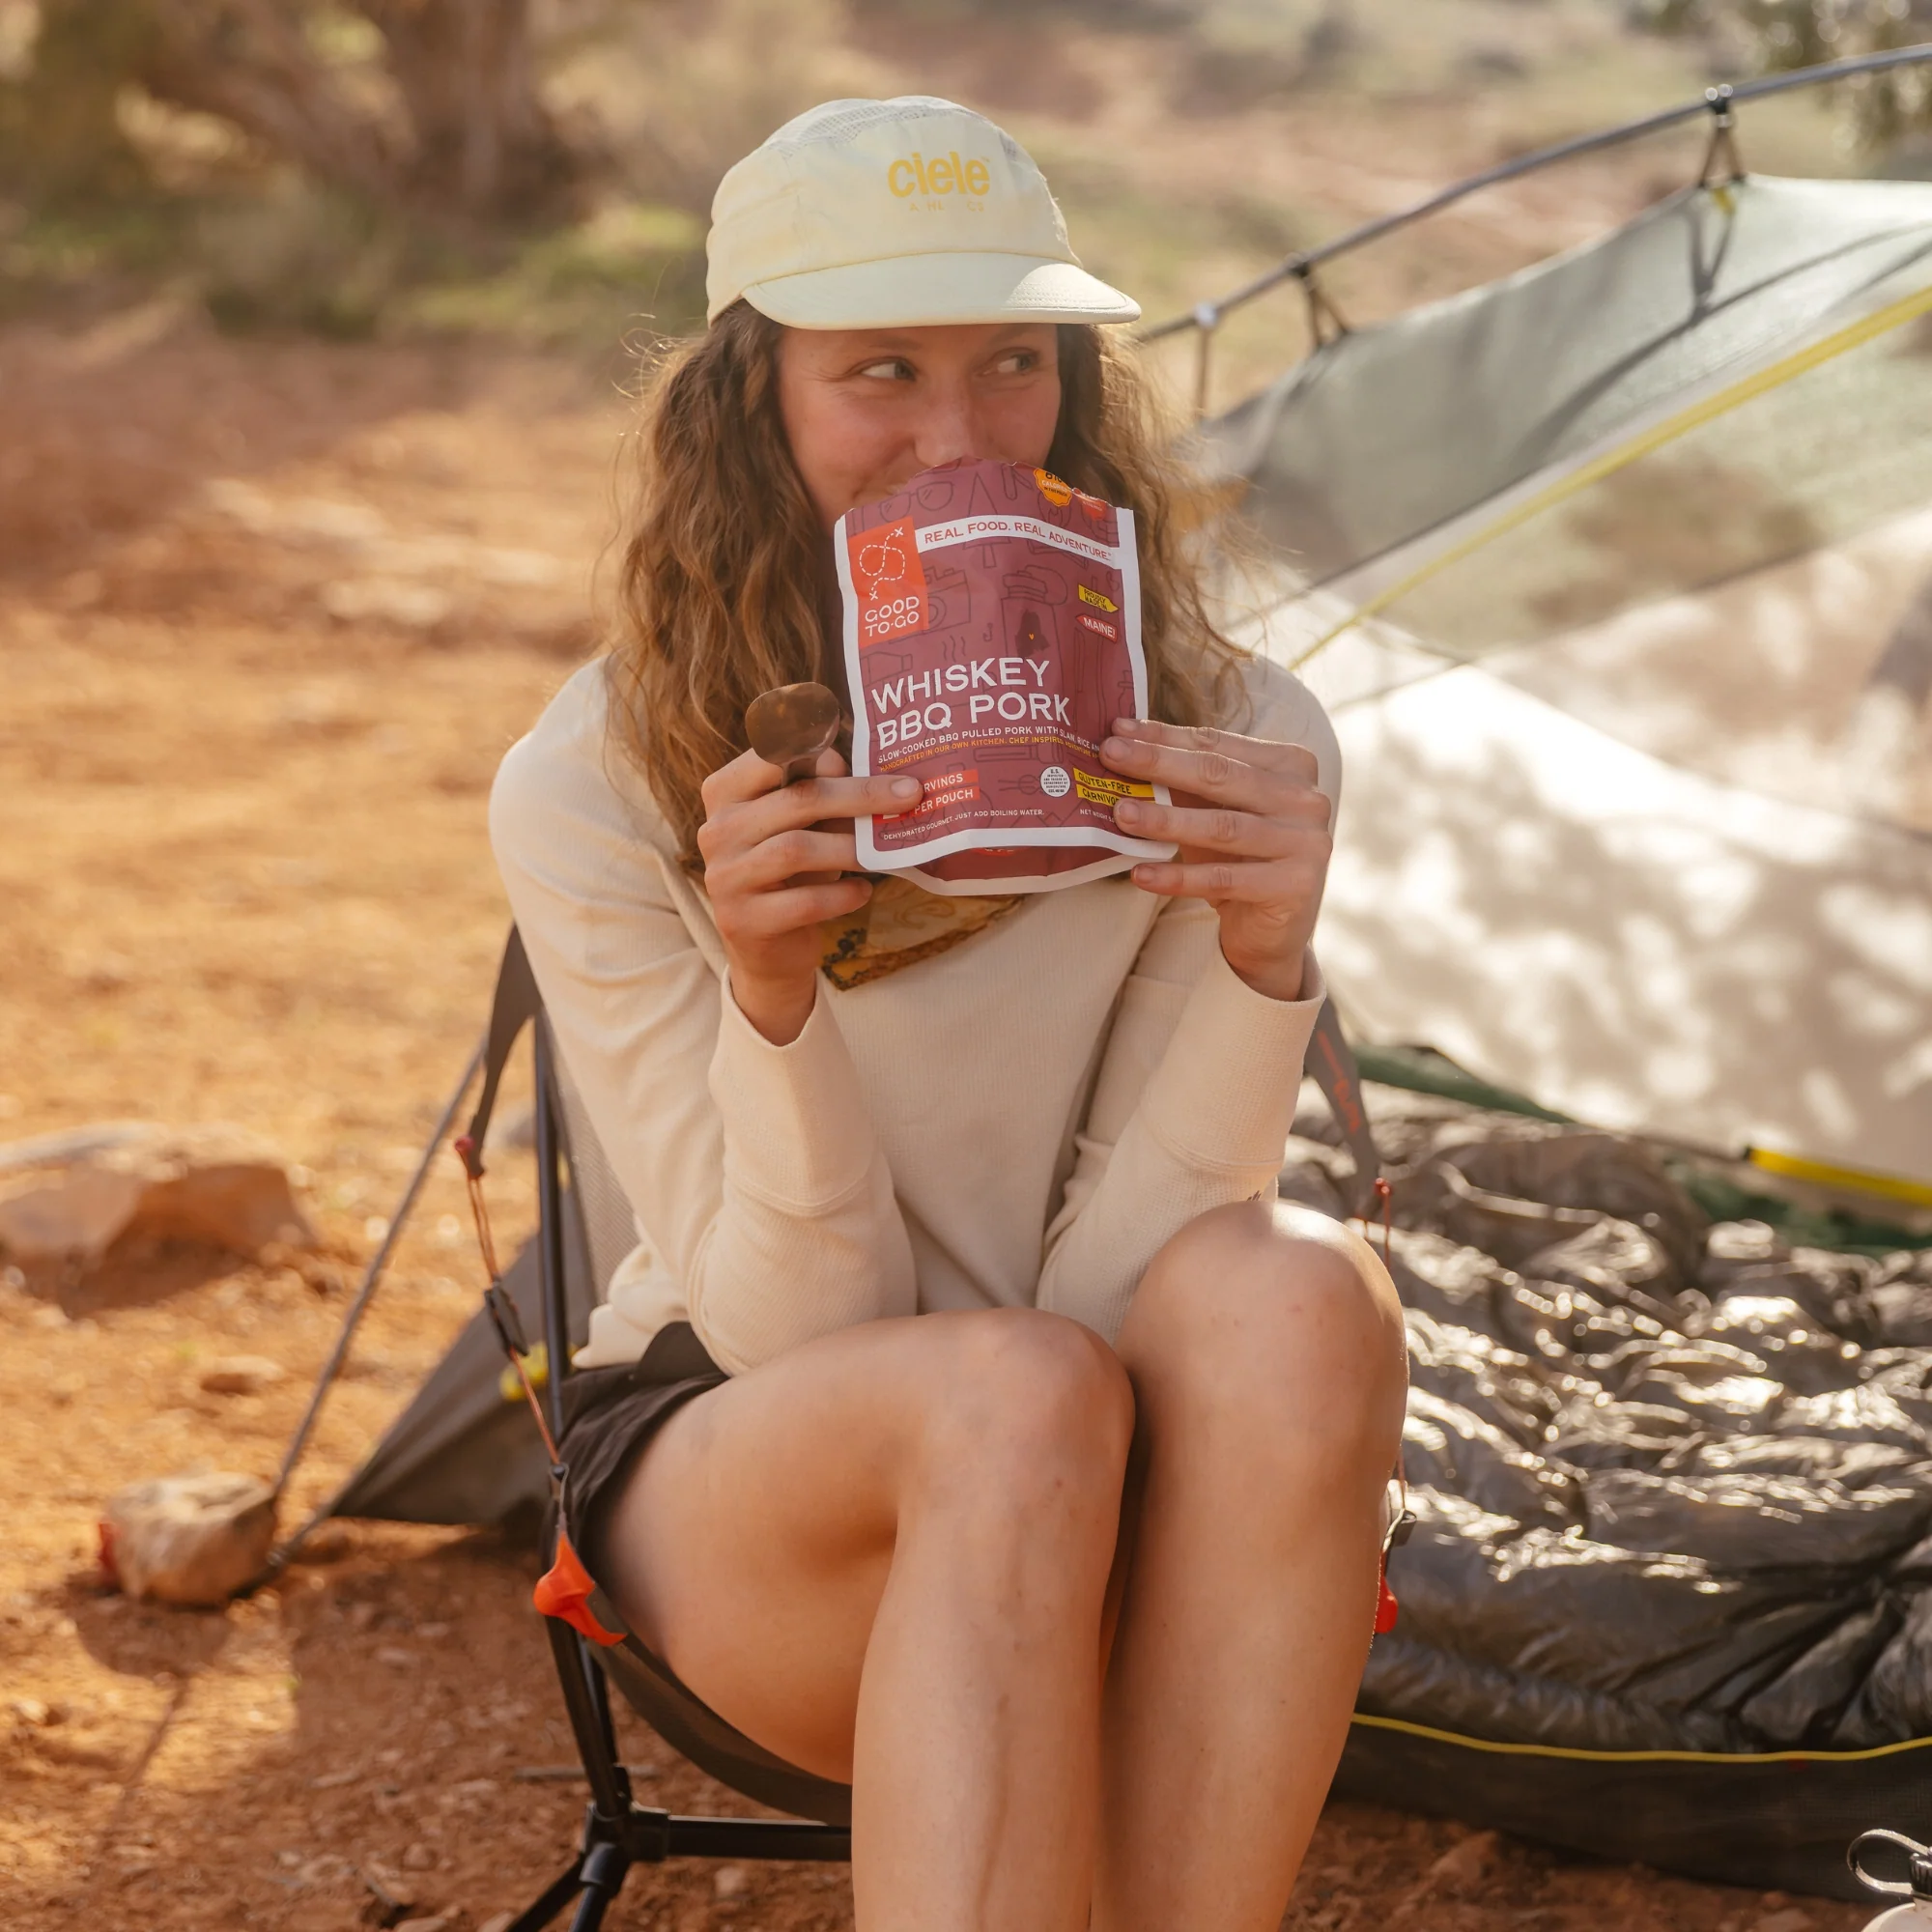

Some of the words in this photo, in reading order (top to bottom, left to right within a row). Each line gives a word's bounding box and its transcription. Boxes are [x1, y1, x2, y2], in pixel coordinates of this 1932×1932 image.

[888, 151, 990, 198] ciele
[924, 526, 964, 544] REAL
[968, 521, 1010, 534] FOOD.
[1014, 522, 1045, 538] REAL
[865, 596, 920, 622] GOOD
[1083, 616, 1116, 639] MAINE!
[871, 657, 1050, 715] WHISKEY
[876, 702, 952, 751] BBQ
[970, 692, 1071, 726] PORK
[878, 737, 937, 764] SLOW-COOKED
[939, 732, 959, 744] BBQ
[962, 727, 1002, 740] PULLED
[1005, 725, 1033, 735] PORK
[1035, 725, 1059, 735] WITH
[1077, 736, 1091, 749] RICE
[880, 752, 924, 772] HANDCRAFTED
[934, 745, 950, 753] OUR
[952, 741, 969, 750] OWN
[971, 737, 1008, 747] KITCHEN.
[923, 773, 964, 793] RVINGS
[1078, 772, 1132, 794] GLUTEN-FREE
[914, 799, 933, 814] PER
[935, 788, 974, 808] POUCH
[883, 826, 925, 840] DEHYDRATED
[954, 811, 972, 821] JUST
